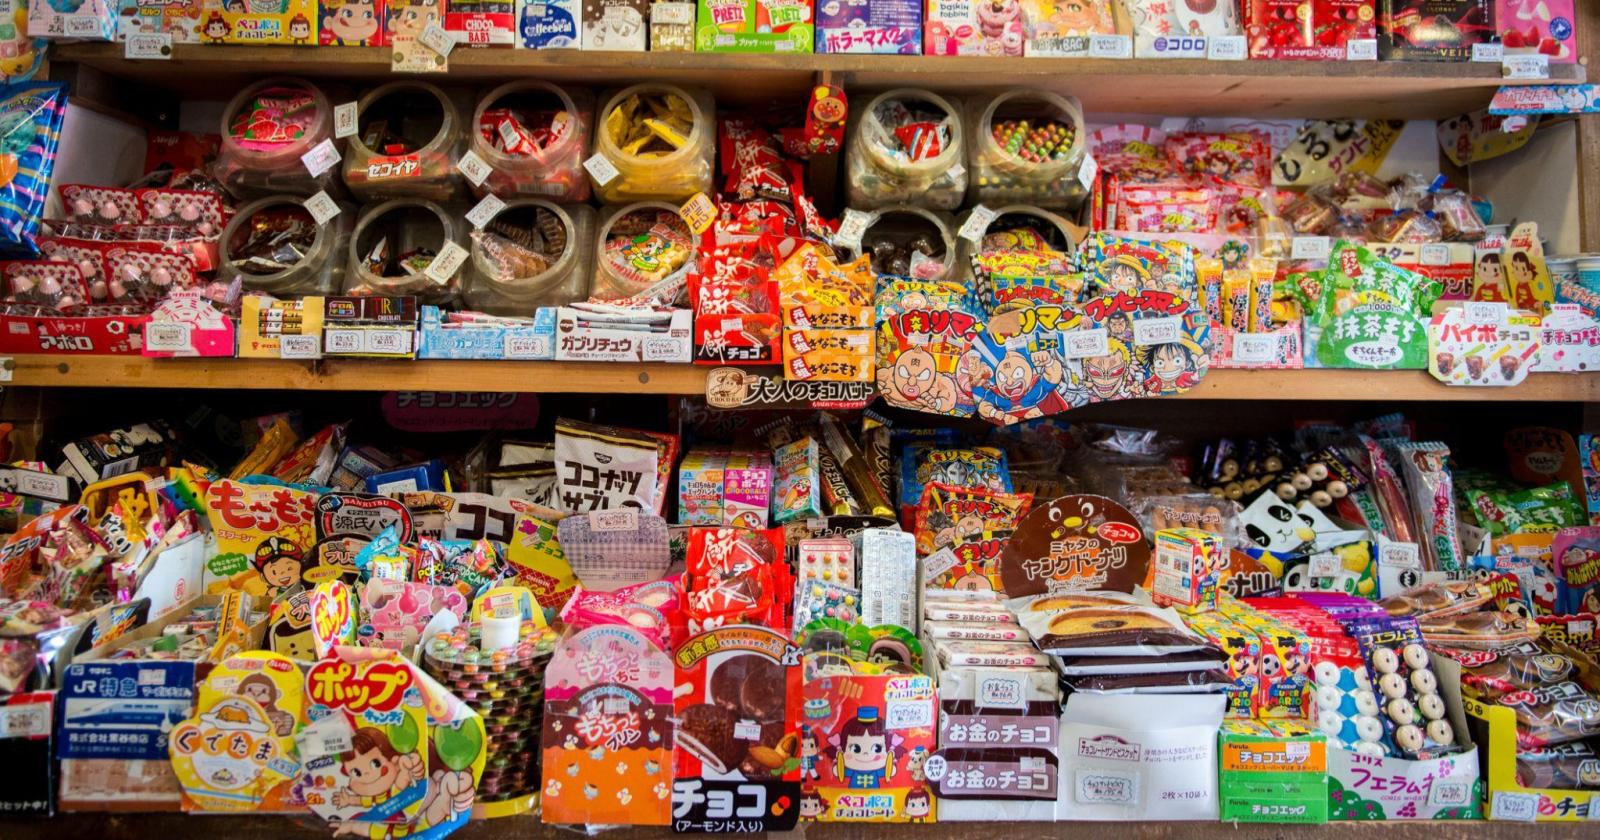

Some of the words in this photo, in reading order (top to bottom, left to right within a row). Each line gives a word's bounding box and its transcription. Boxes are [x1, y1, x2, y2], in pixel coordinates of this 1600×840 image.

[714, 8, 743, 24] PRETZ
[771, 8, 800, 25] PRETZ
[466, 19, 494, 31] CHOCO
[827, 29, 901, 53] ホラーマスク
[1168, 39, 1205, 51] コロロ
[1440, 49, 1471, 60] VEIL
[368, 160, 416, 177] セコイヤ
[1085, 287, 1190, 322] ワンピースマン
[1441, 323, 1499, 343] パイポ
[1500, 330, 1531, 341] チョコ
[40, 335, 93, 351] アポロ
[561, 336, 632, 352] ガブリチュウ
[727, 350, 761, 366] チョコ
[743, 378, 877, 405] 大人のチョコバット
[564, 461, 643, 495] ココナッツ
[1050, 540, 1098, 554] ミヤタの
[1022, 547, 1127, 582] ヤングドーナツ
[678, 633, 720, 666] 新食感
[74, 680, 97, 693] JR
[99, 677, 139, 697] 特急
[312, 663, 409, 710] ポップ
[364, 711, 405, 725] キャンディ
[575, 712, 640, 742] もちっと
[950, 724, 1051, 746] お金のチョコ
[178, 731, 272, 760] ぐでたま
[272, 759, 294, 774] チョコ
[1351, 753, 1383, 767] コリス
[948, 774, 1050, 793] お金のチョコ
[673, 781, 767, 819] チョコ
[837, 794, 893, 808] ペコポコ
[835, 807, 895, 819] チョコレート
[1252, 804, 1306, 814] チョコエッグ
[675, 819, 764, 834] (アーモンド入り)
